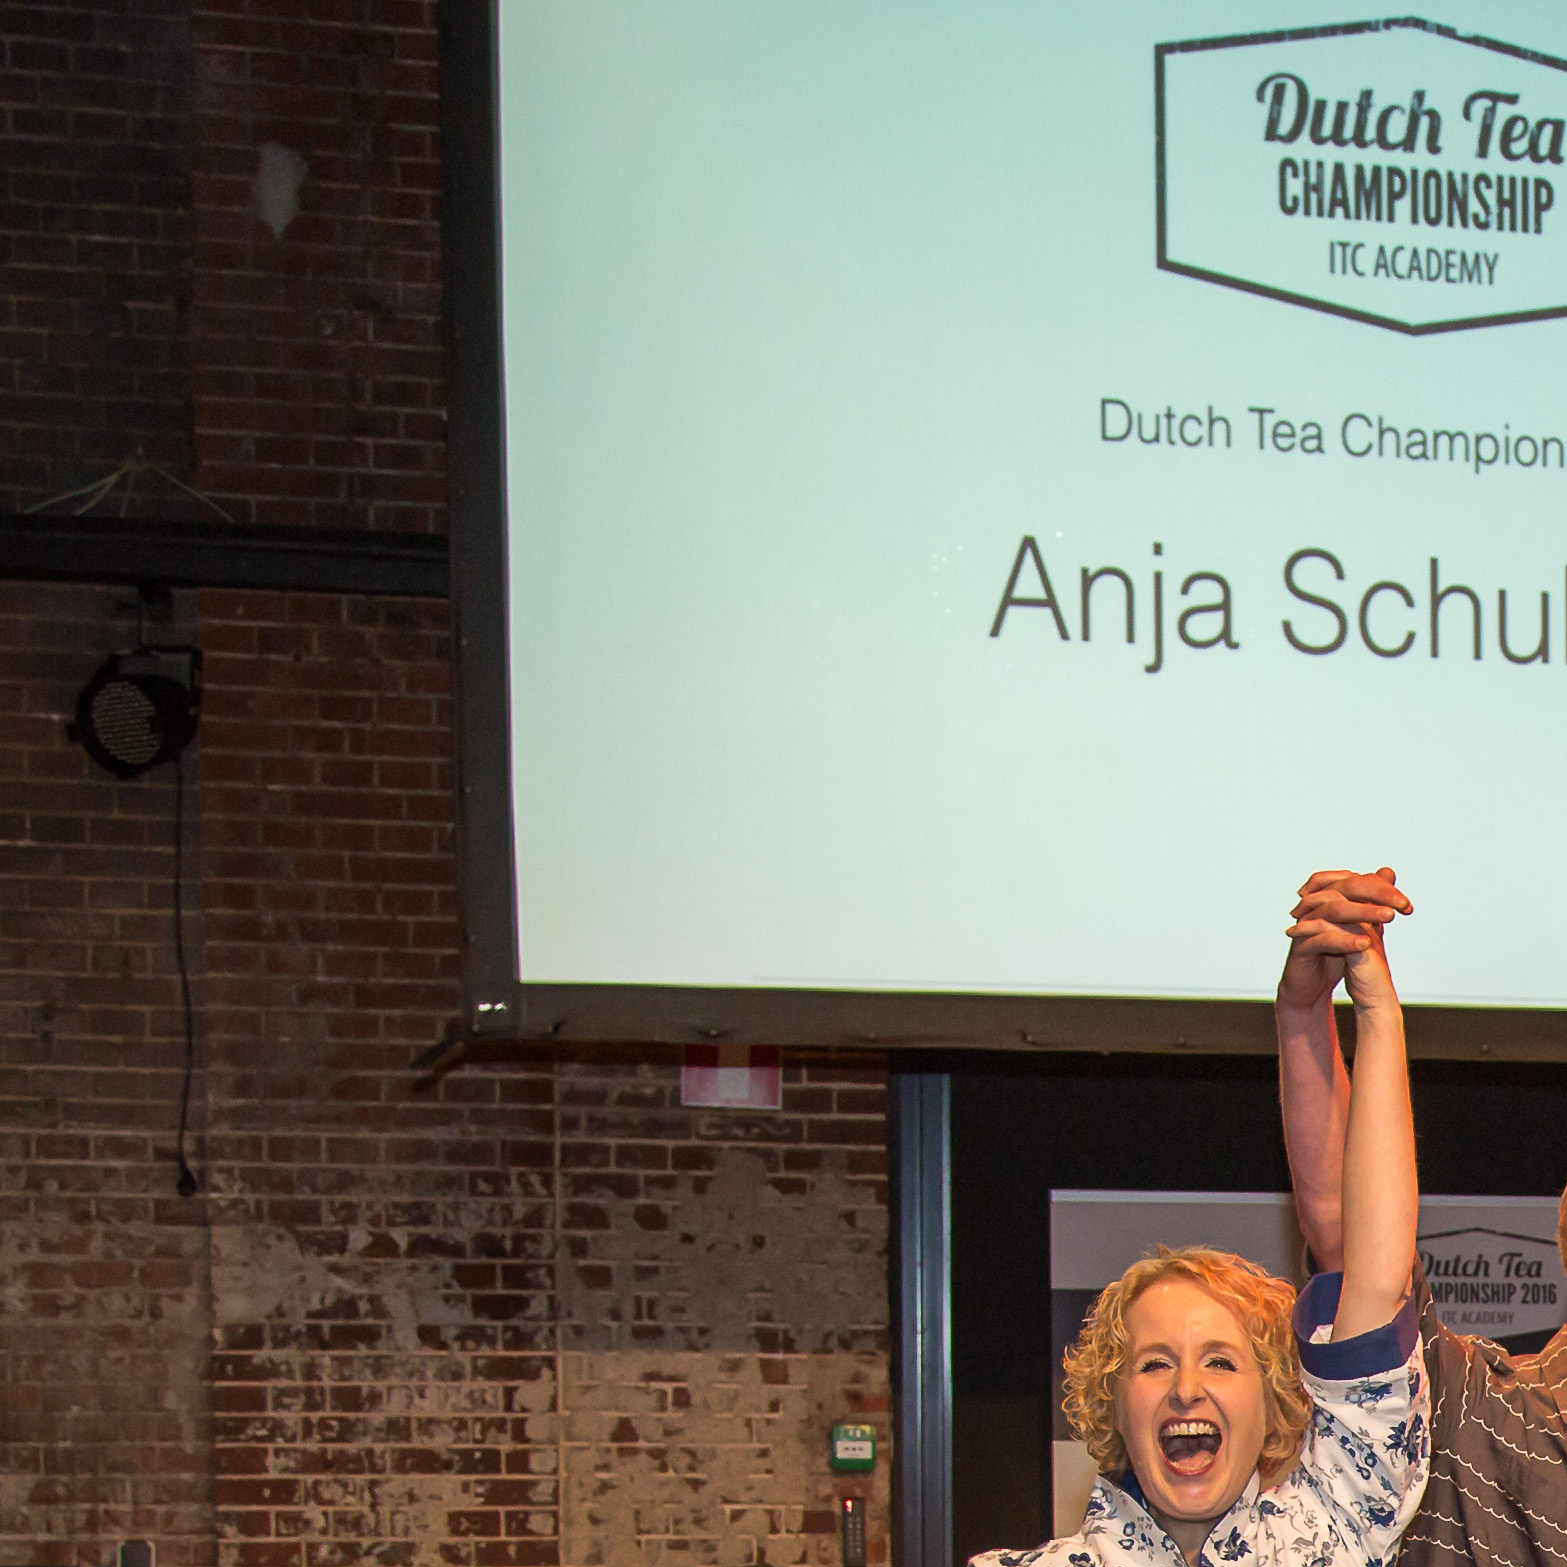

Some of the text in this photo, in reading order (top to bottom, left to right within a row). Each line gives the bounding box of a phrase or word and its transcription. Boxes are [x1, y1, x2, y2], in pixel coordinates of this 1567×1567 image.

[1256, 72, 1566, 165] Dutch Tea
[1278, 157, 1554, 234] CHAMPIONSHIP
[1329, 241, 1499, 286] ITC ACADEMY
[1099, 397, 1231, 449] Dutch
[1248, 408, 1325, 455] Tea
[1341, 412, 1566, 475] Champion
[989, 535, 1240, 674] Anja
[1430, 1281, 1558, 1305] MPIONSHIP 2016
[1498, 1252, 1543, 1278] Tea
[1441, 1310, 1516, 1325] ITC ACADEMY
